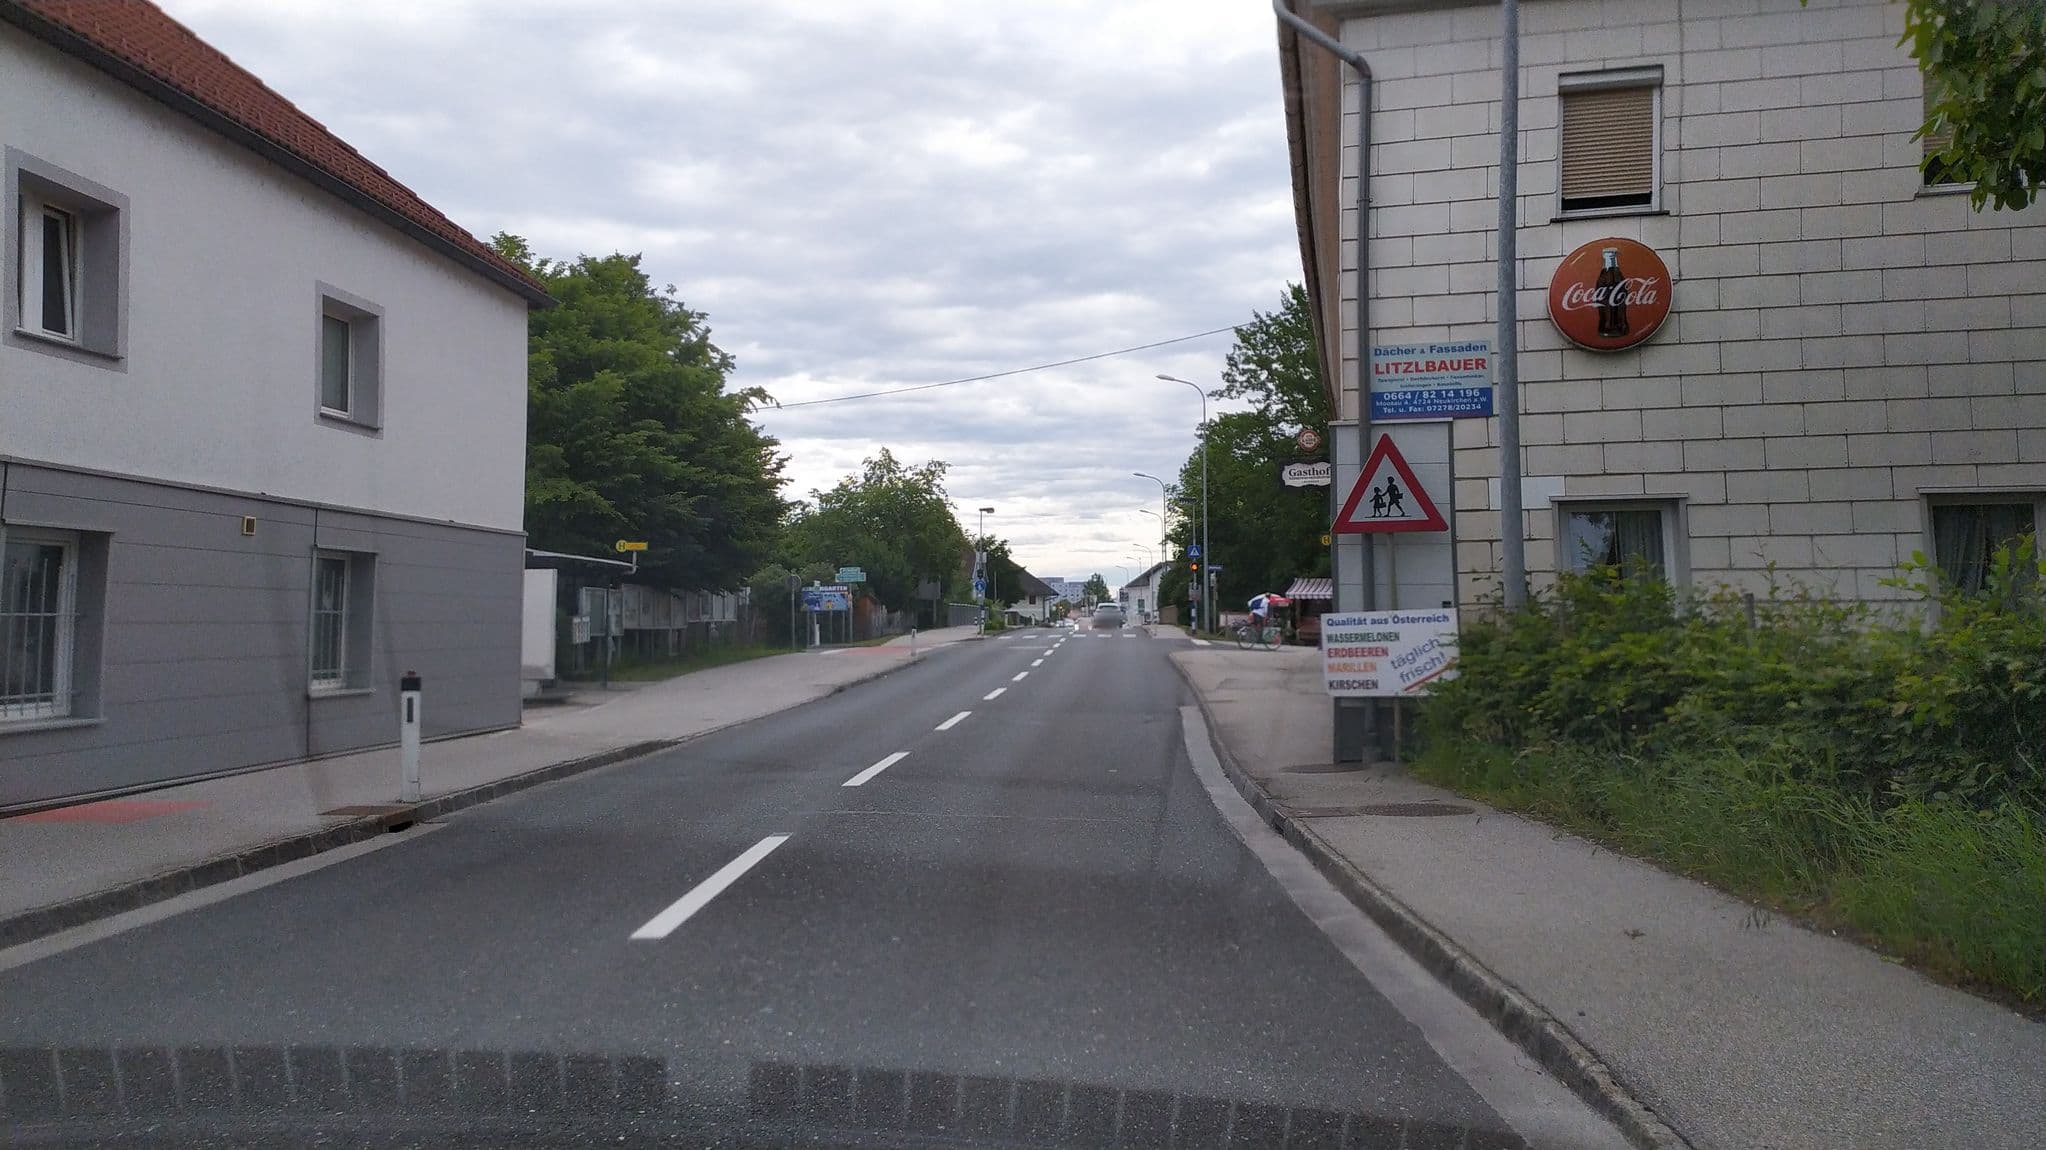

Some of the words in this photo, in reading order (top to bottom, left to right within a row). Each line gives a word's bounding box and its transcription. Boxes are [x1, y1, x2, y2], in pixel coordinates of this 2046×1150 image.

[1562, 276, 1660, 311] Coca-Cola
[1374, 346, 1417, 356] Dächer
[1429, 343, 1488, 354] Fassaden
[1374, 358, 1487, 376] LITZLBAUER
[1383, 391, 1412, 401] 0664
[1422, 390, 1437, 399] 82
[1441, 389, 1455, 399] 14
[1459, 388, 1480, 398] 196
[1288, 467, 1331, 476] Gasthof
[1326, 616, 1367, 627] Qualität
[1370, 617, 1389, 625] aus
[1392, 614, 1450, 625] Österreich
[1326, 631, 1400, 644] WASSERMELONEN
[1327, 647, 1389, 658] ERDBEEREN
[1390, 637, 1442, 670] täglich
[1399, 651, 1447, 684] frisch!
[1328, 679, 1379, 690] KIRSCHEN
